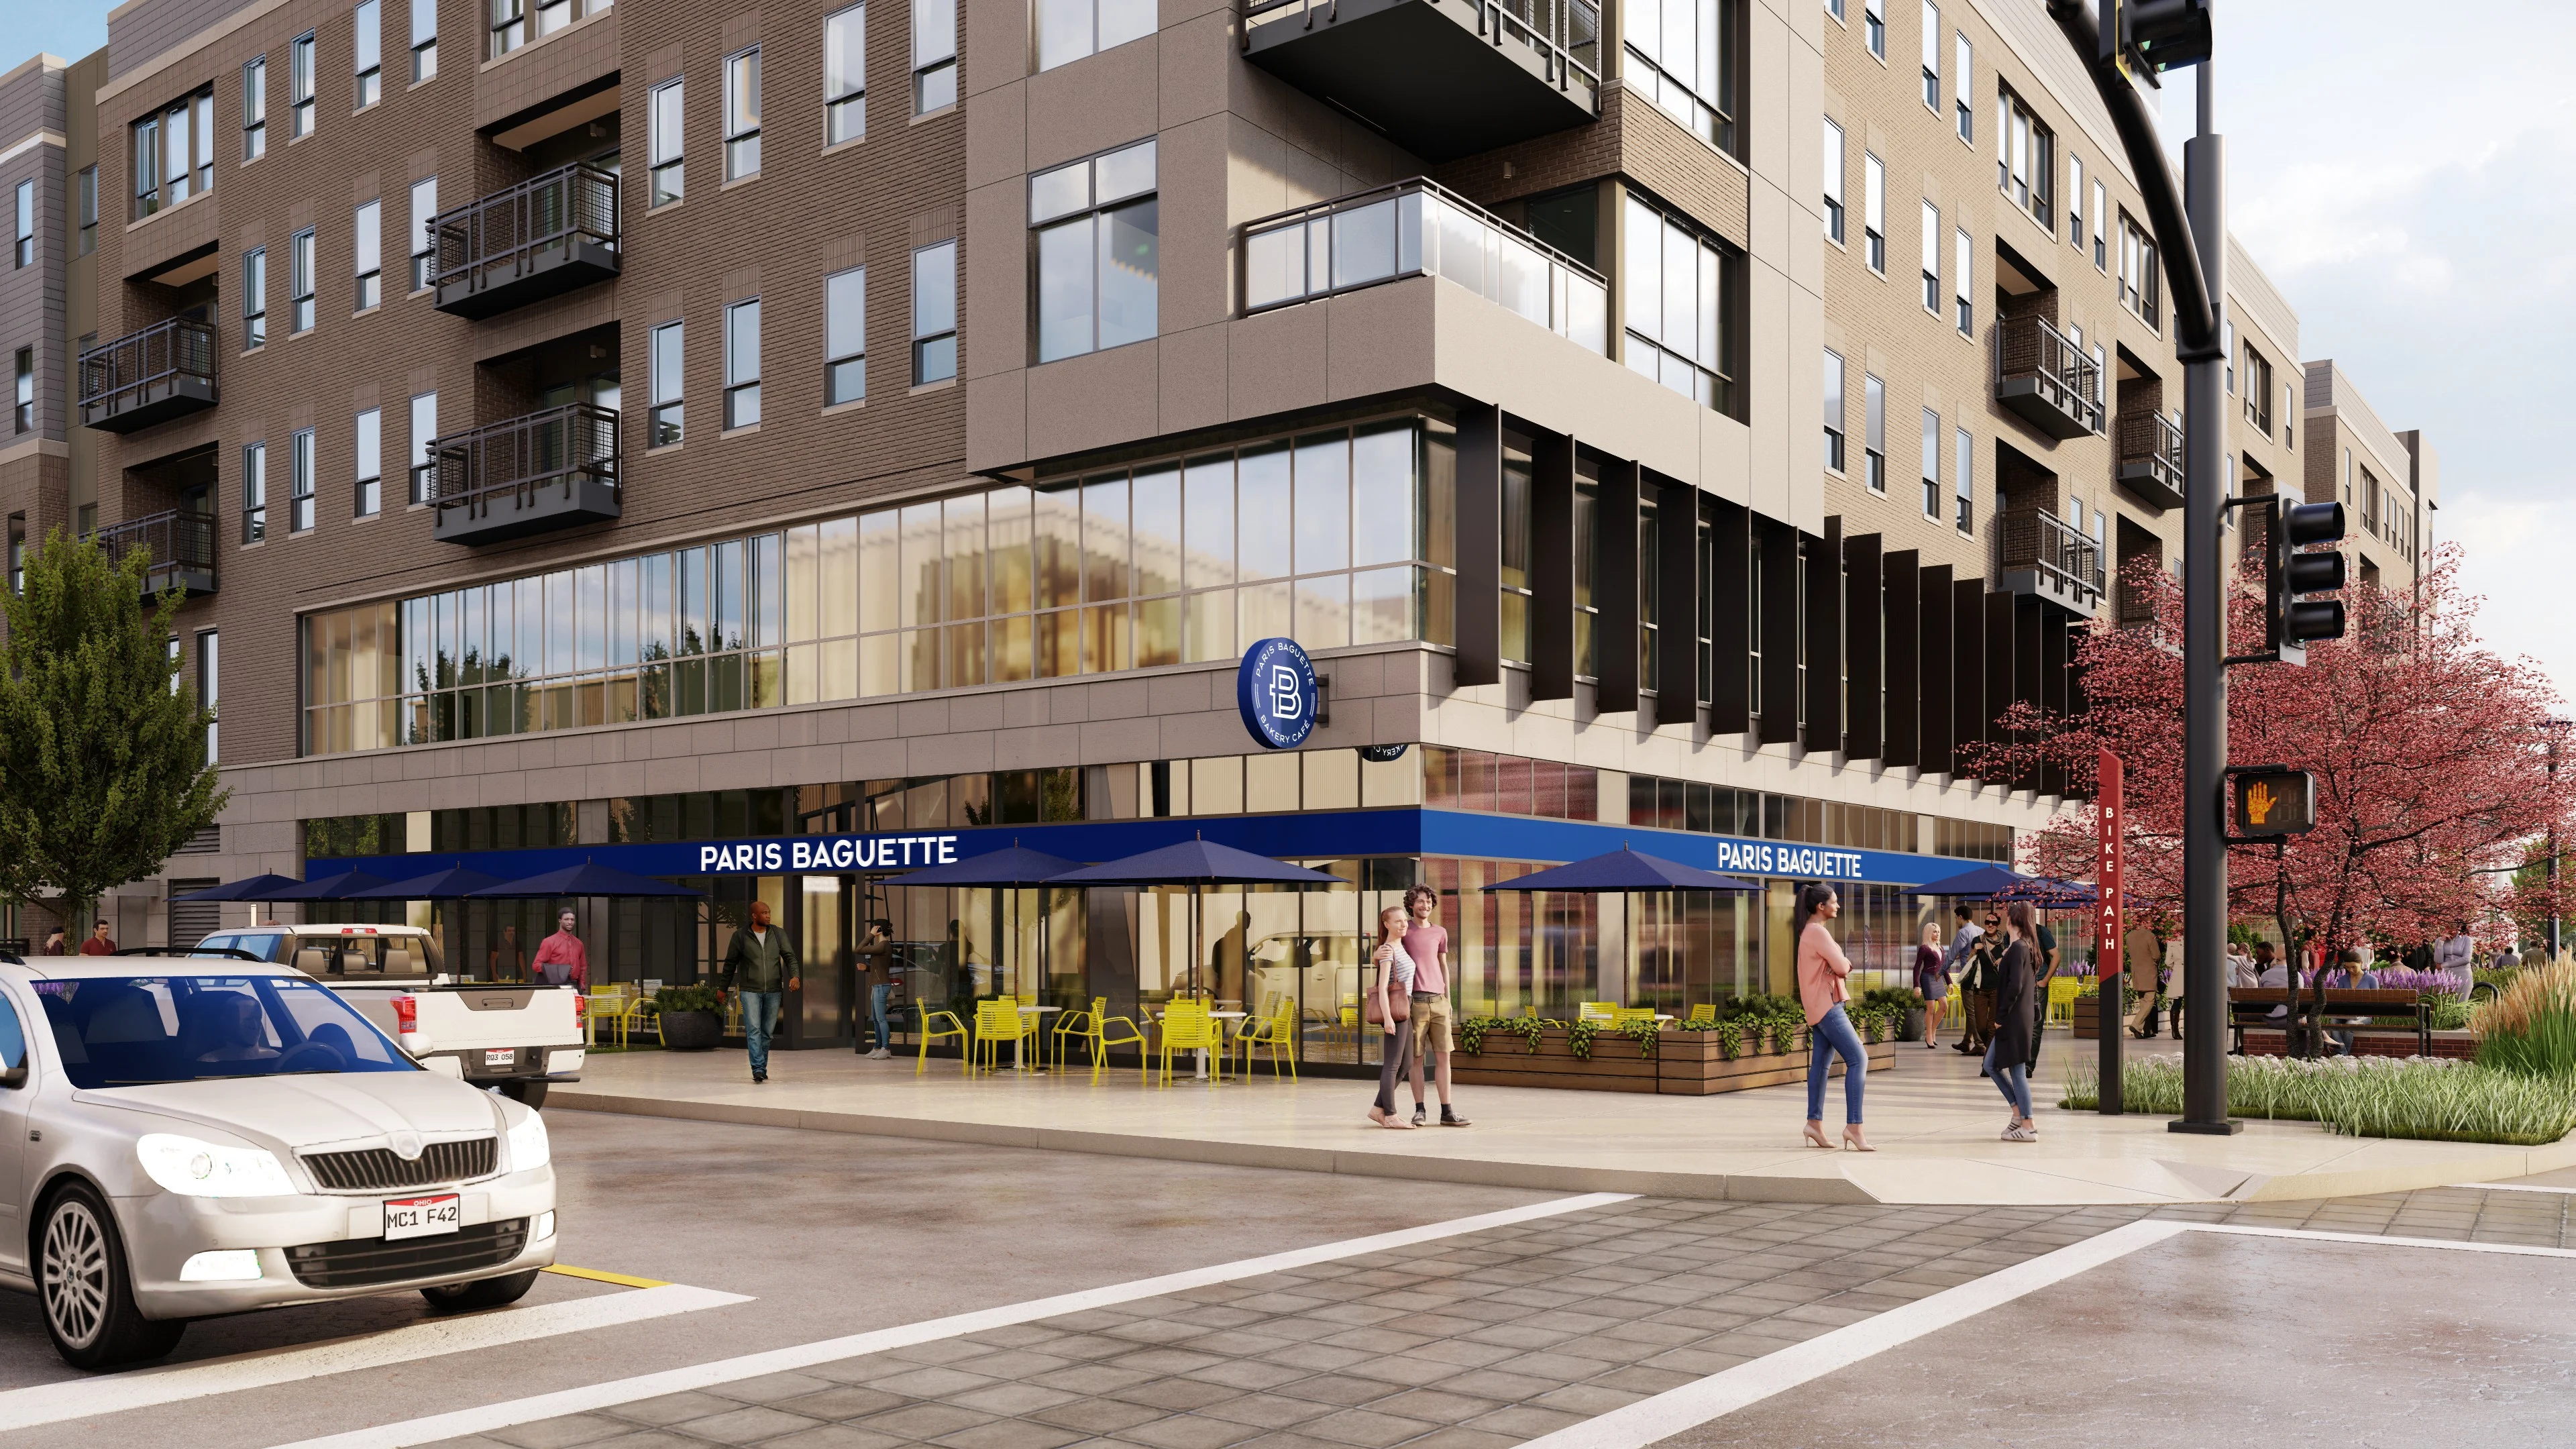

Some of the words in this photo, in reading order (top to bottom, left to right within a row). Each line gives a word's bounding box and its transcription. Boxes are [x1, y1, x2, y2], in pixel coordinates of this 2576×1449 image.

[1256, 645, 1275, 678] PARIS
[1277, 642, 1314, 686] BAGUETTE
[1260, 714, 1290, 743] BAKERY
[1292, 719, 1310, 742] CAFÉ
[700, 843, 783, 871] PARIS
[792, 836, 959, 869] BAGUETTE
[2104, 807, 2114, 872] BIKE
[1718, 842, 1772, 872] PARIS
[1777, 847, 1862, 877] BAGUETTE
[2104, 888, 2114, 950] PATH
[387, 1211, 419, 1228] MC1
[427, 1206, 457, 1224] F42
